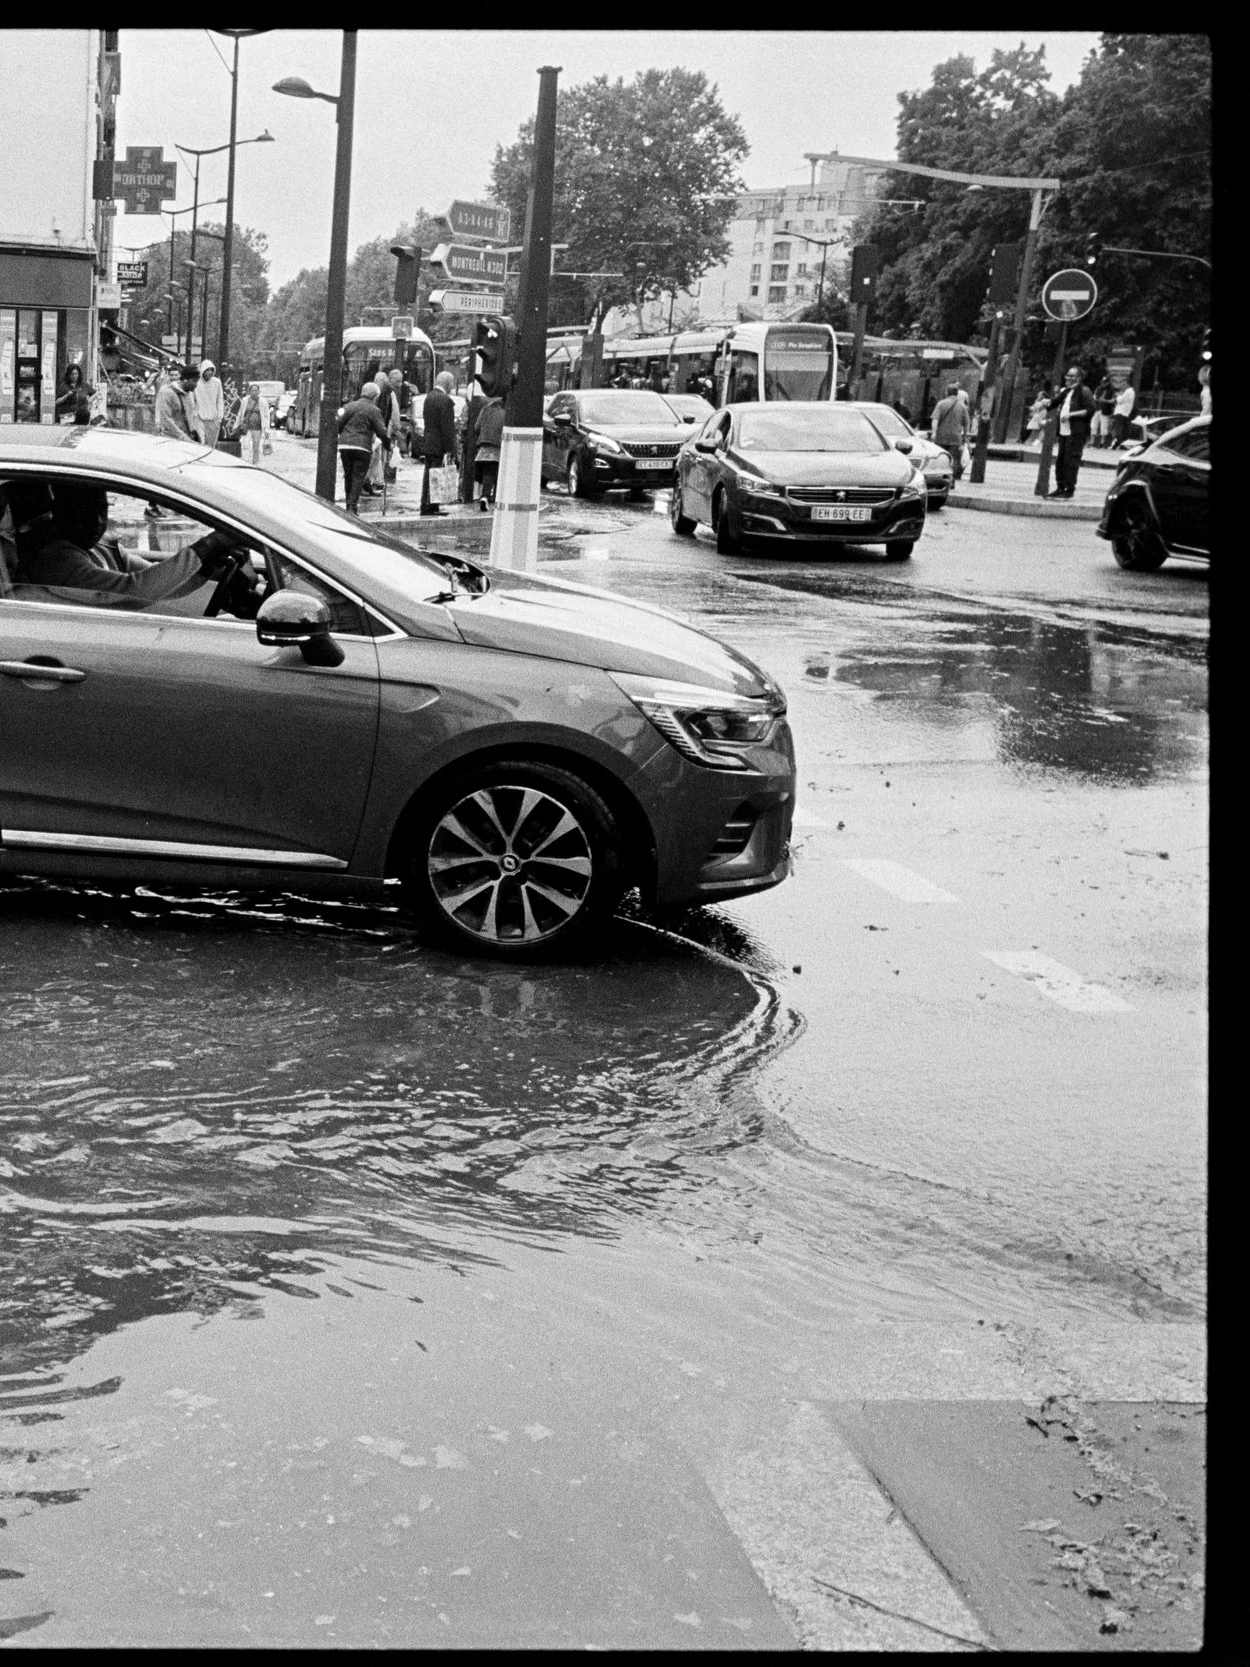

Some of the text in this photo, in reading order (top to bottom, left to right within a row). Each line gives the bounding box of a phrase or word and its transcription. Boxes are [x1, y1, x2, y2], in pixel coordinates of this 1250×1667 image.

[818, 508, 864, 519] EH 699 EE
